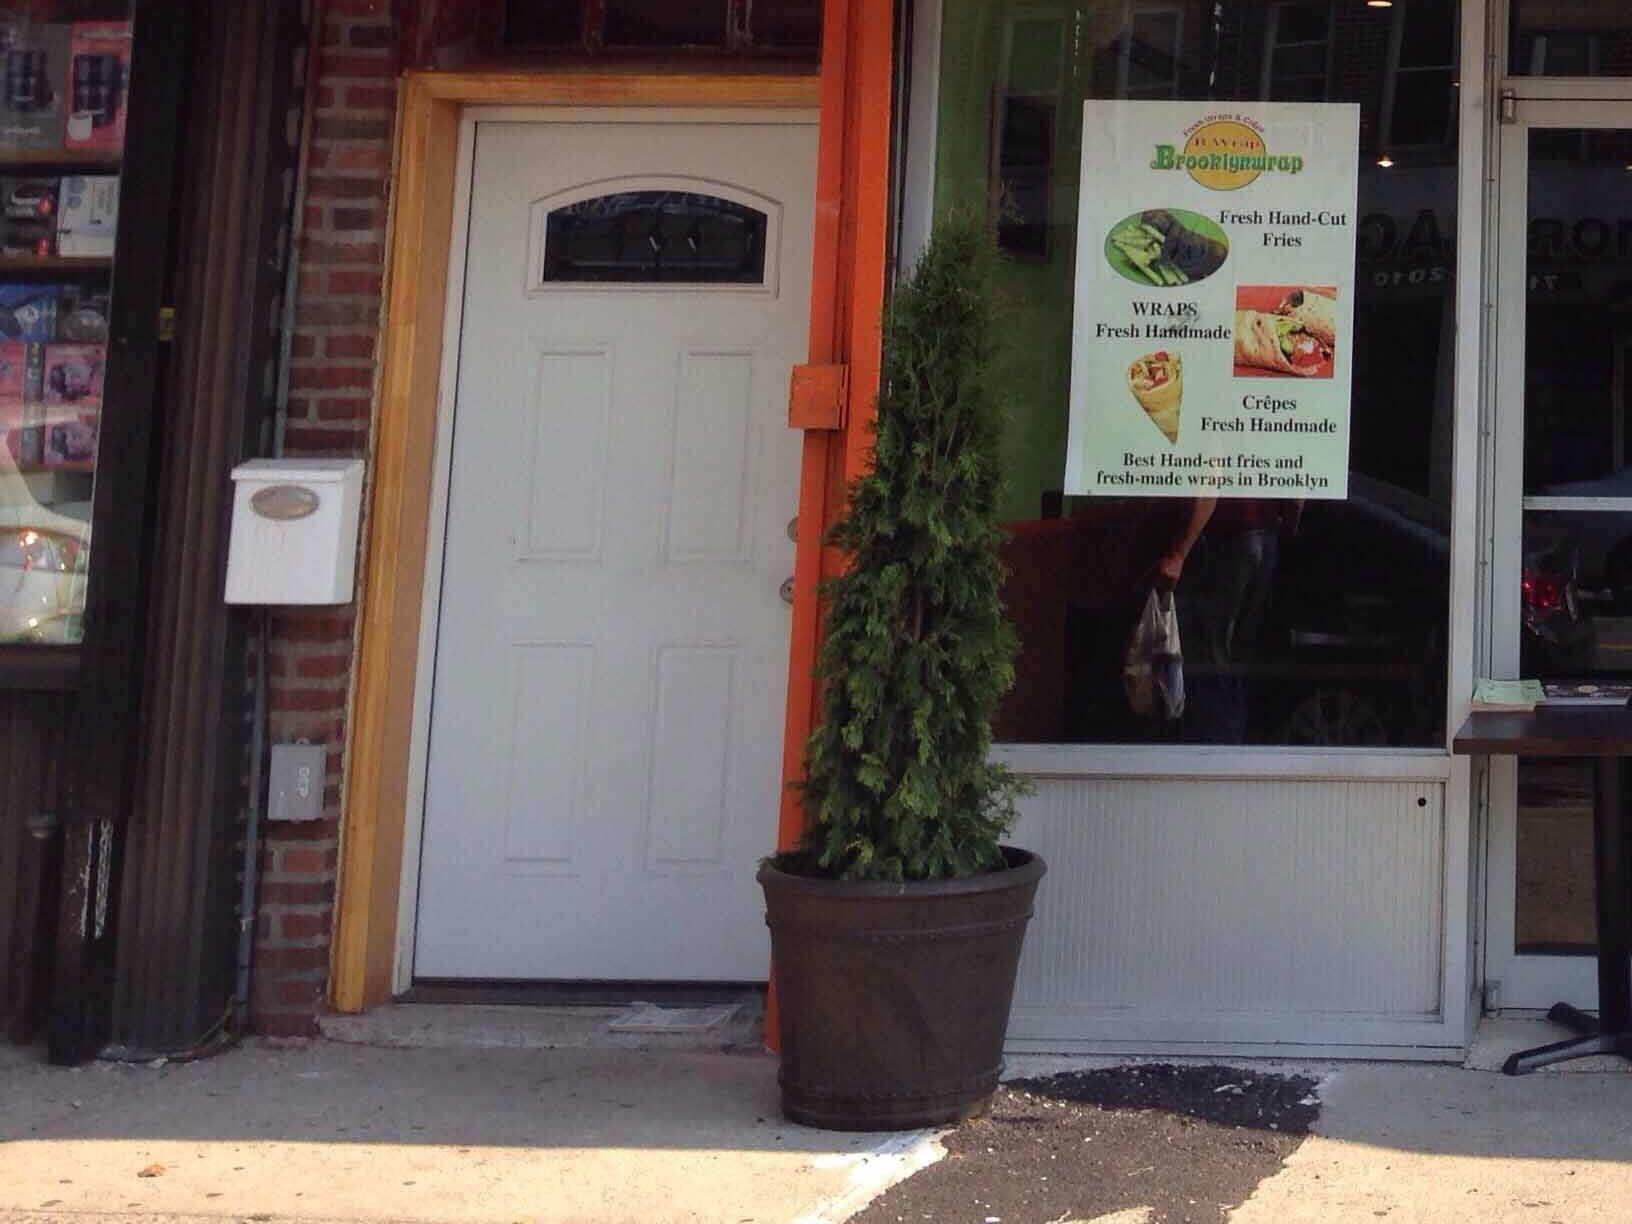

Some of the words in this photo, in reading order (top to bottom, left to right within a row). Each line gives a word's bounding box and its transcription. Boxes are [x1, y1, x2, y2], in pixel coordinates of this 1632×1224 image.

[1219, 210, 1262, 226] Fresh
[1268, 210, 1347, 226] Hand-Cut
[1262, 232, 1302, 247] Fries
[1132, 302, 1198, 317] WRAPS
[1096, 324, 1140, 339] Fresh
[1145, 324, 1232, 340] Handmade
[1243, 395, 1297, 412] Crêpes
[1200, 417, 1245, 432] Fresh
[1250, 417, 1337, 433] Handmade
[1123, 453, 1156, 467] Best
[1160, 453, 1231, 468] Hand-cut
[1237, 454, 1270, 469] fries
[1275, 455, 1303, 469] and
[1096, 471, 1182, 486] fresh-made
[1188, 475, 1234, 491] wraps
[1238, 473, 1252, 486] in
[1258, 473, 1328, 491] Brooklyn
